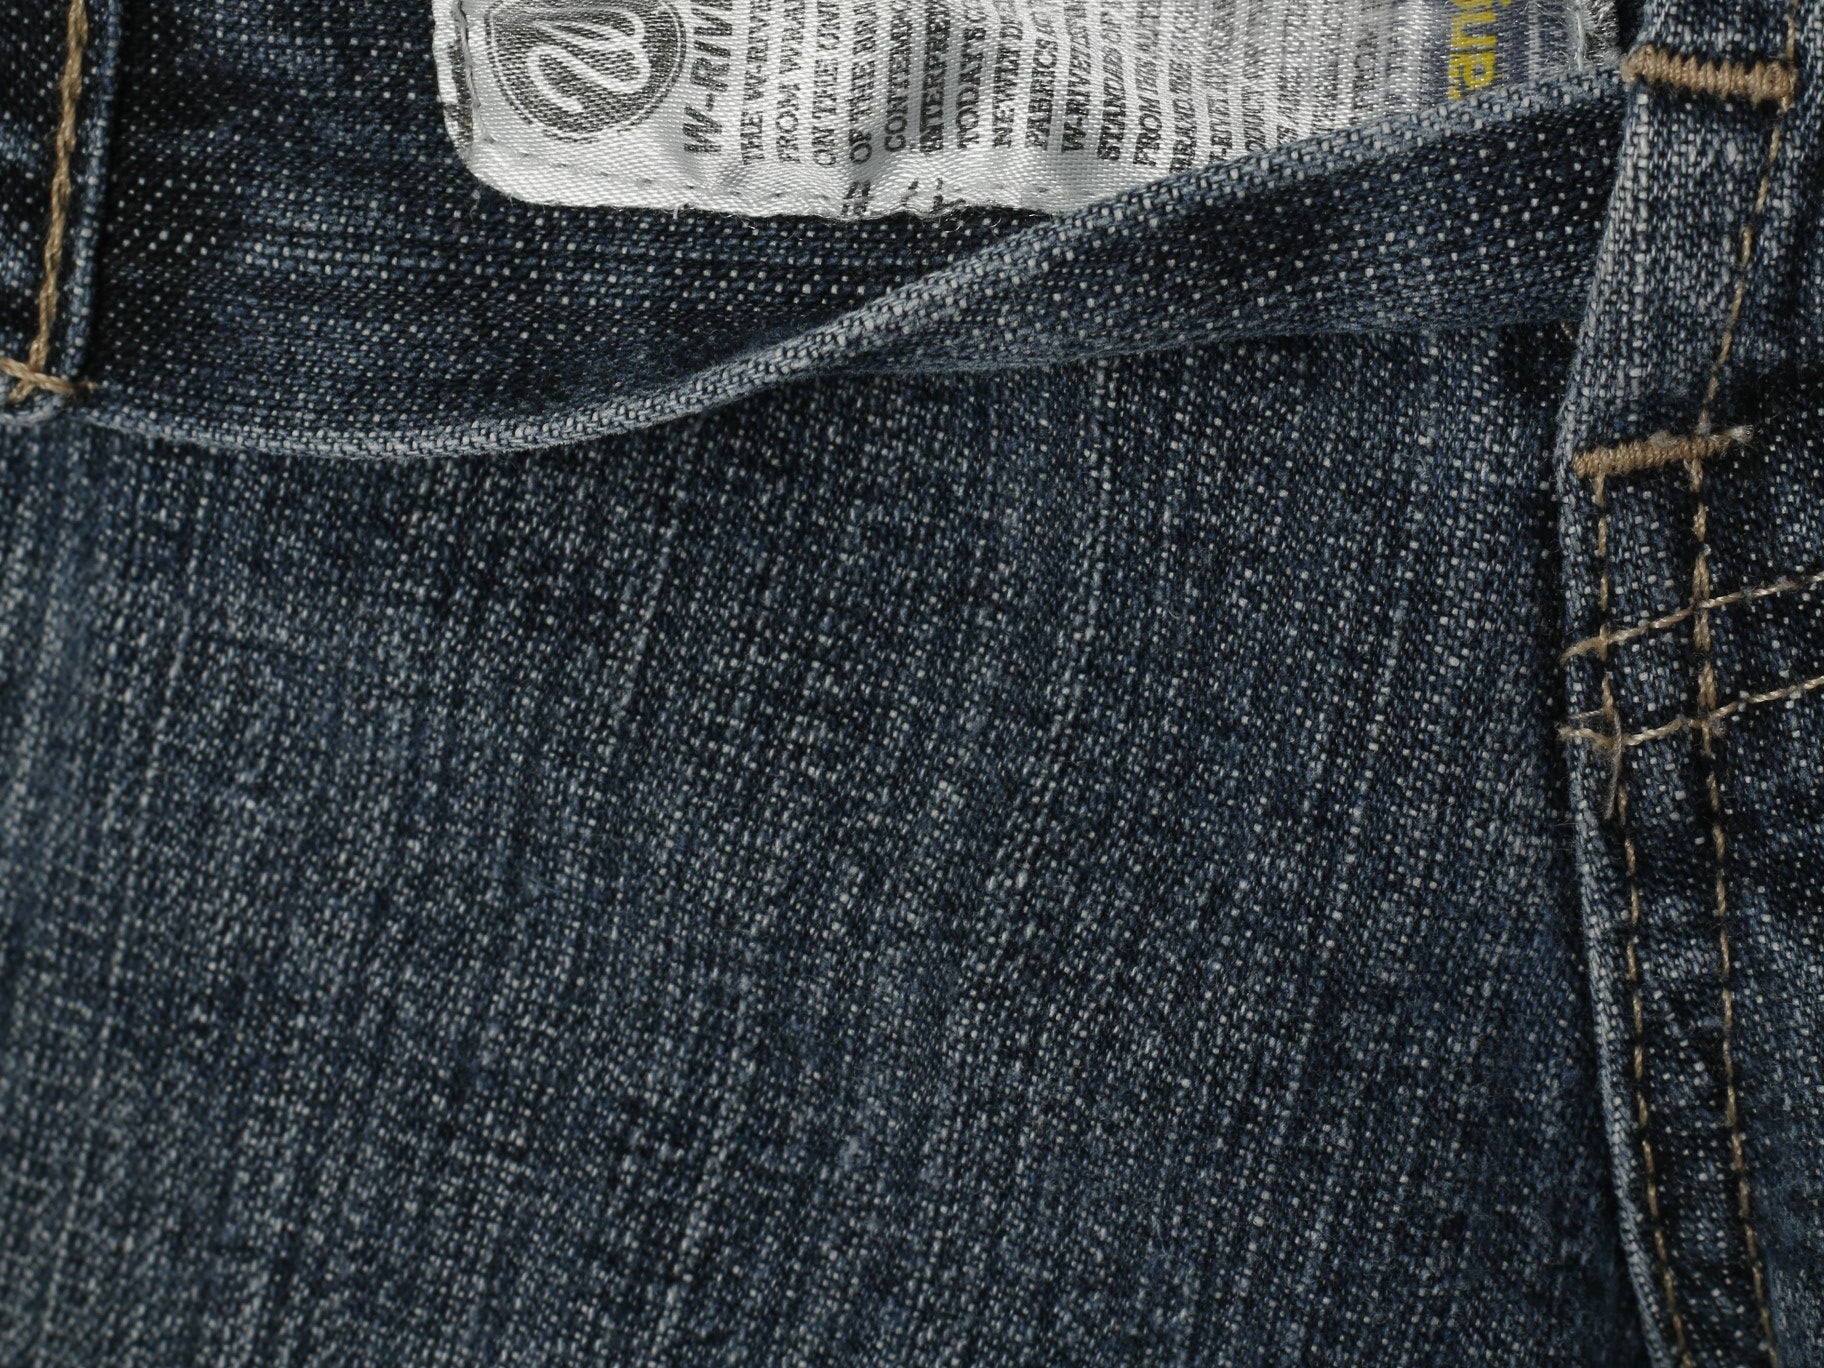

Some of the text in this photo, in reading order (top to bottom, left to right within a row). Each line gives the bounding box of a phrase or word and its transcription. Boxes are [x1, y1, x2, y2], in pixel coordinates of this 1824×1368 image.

[775, 82, 802, 164] FROM
[811, 60, 839, 120] THE
[846, 61, 877, 123] THE
[957, 28, 987, 151] TODAY'S
[992, 47, 1022, 148] NEWLY
[1026, 38, 1059, 152] FABRICS
[1240, 84, 1269, 155] ODUCT
[739, 111, 766, 166] THE
[811, 126, 837, 168] ON
[848, 130, 873, 165] OF
[1133, 96, 1163, 166] FROM
